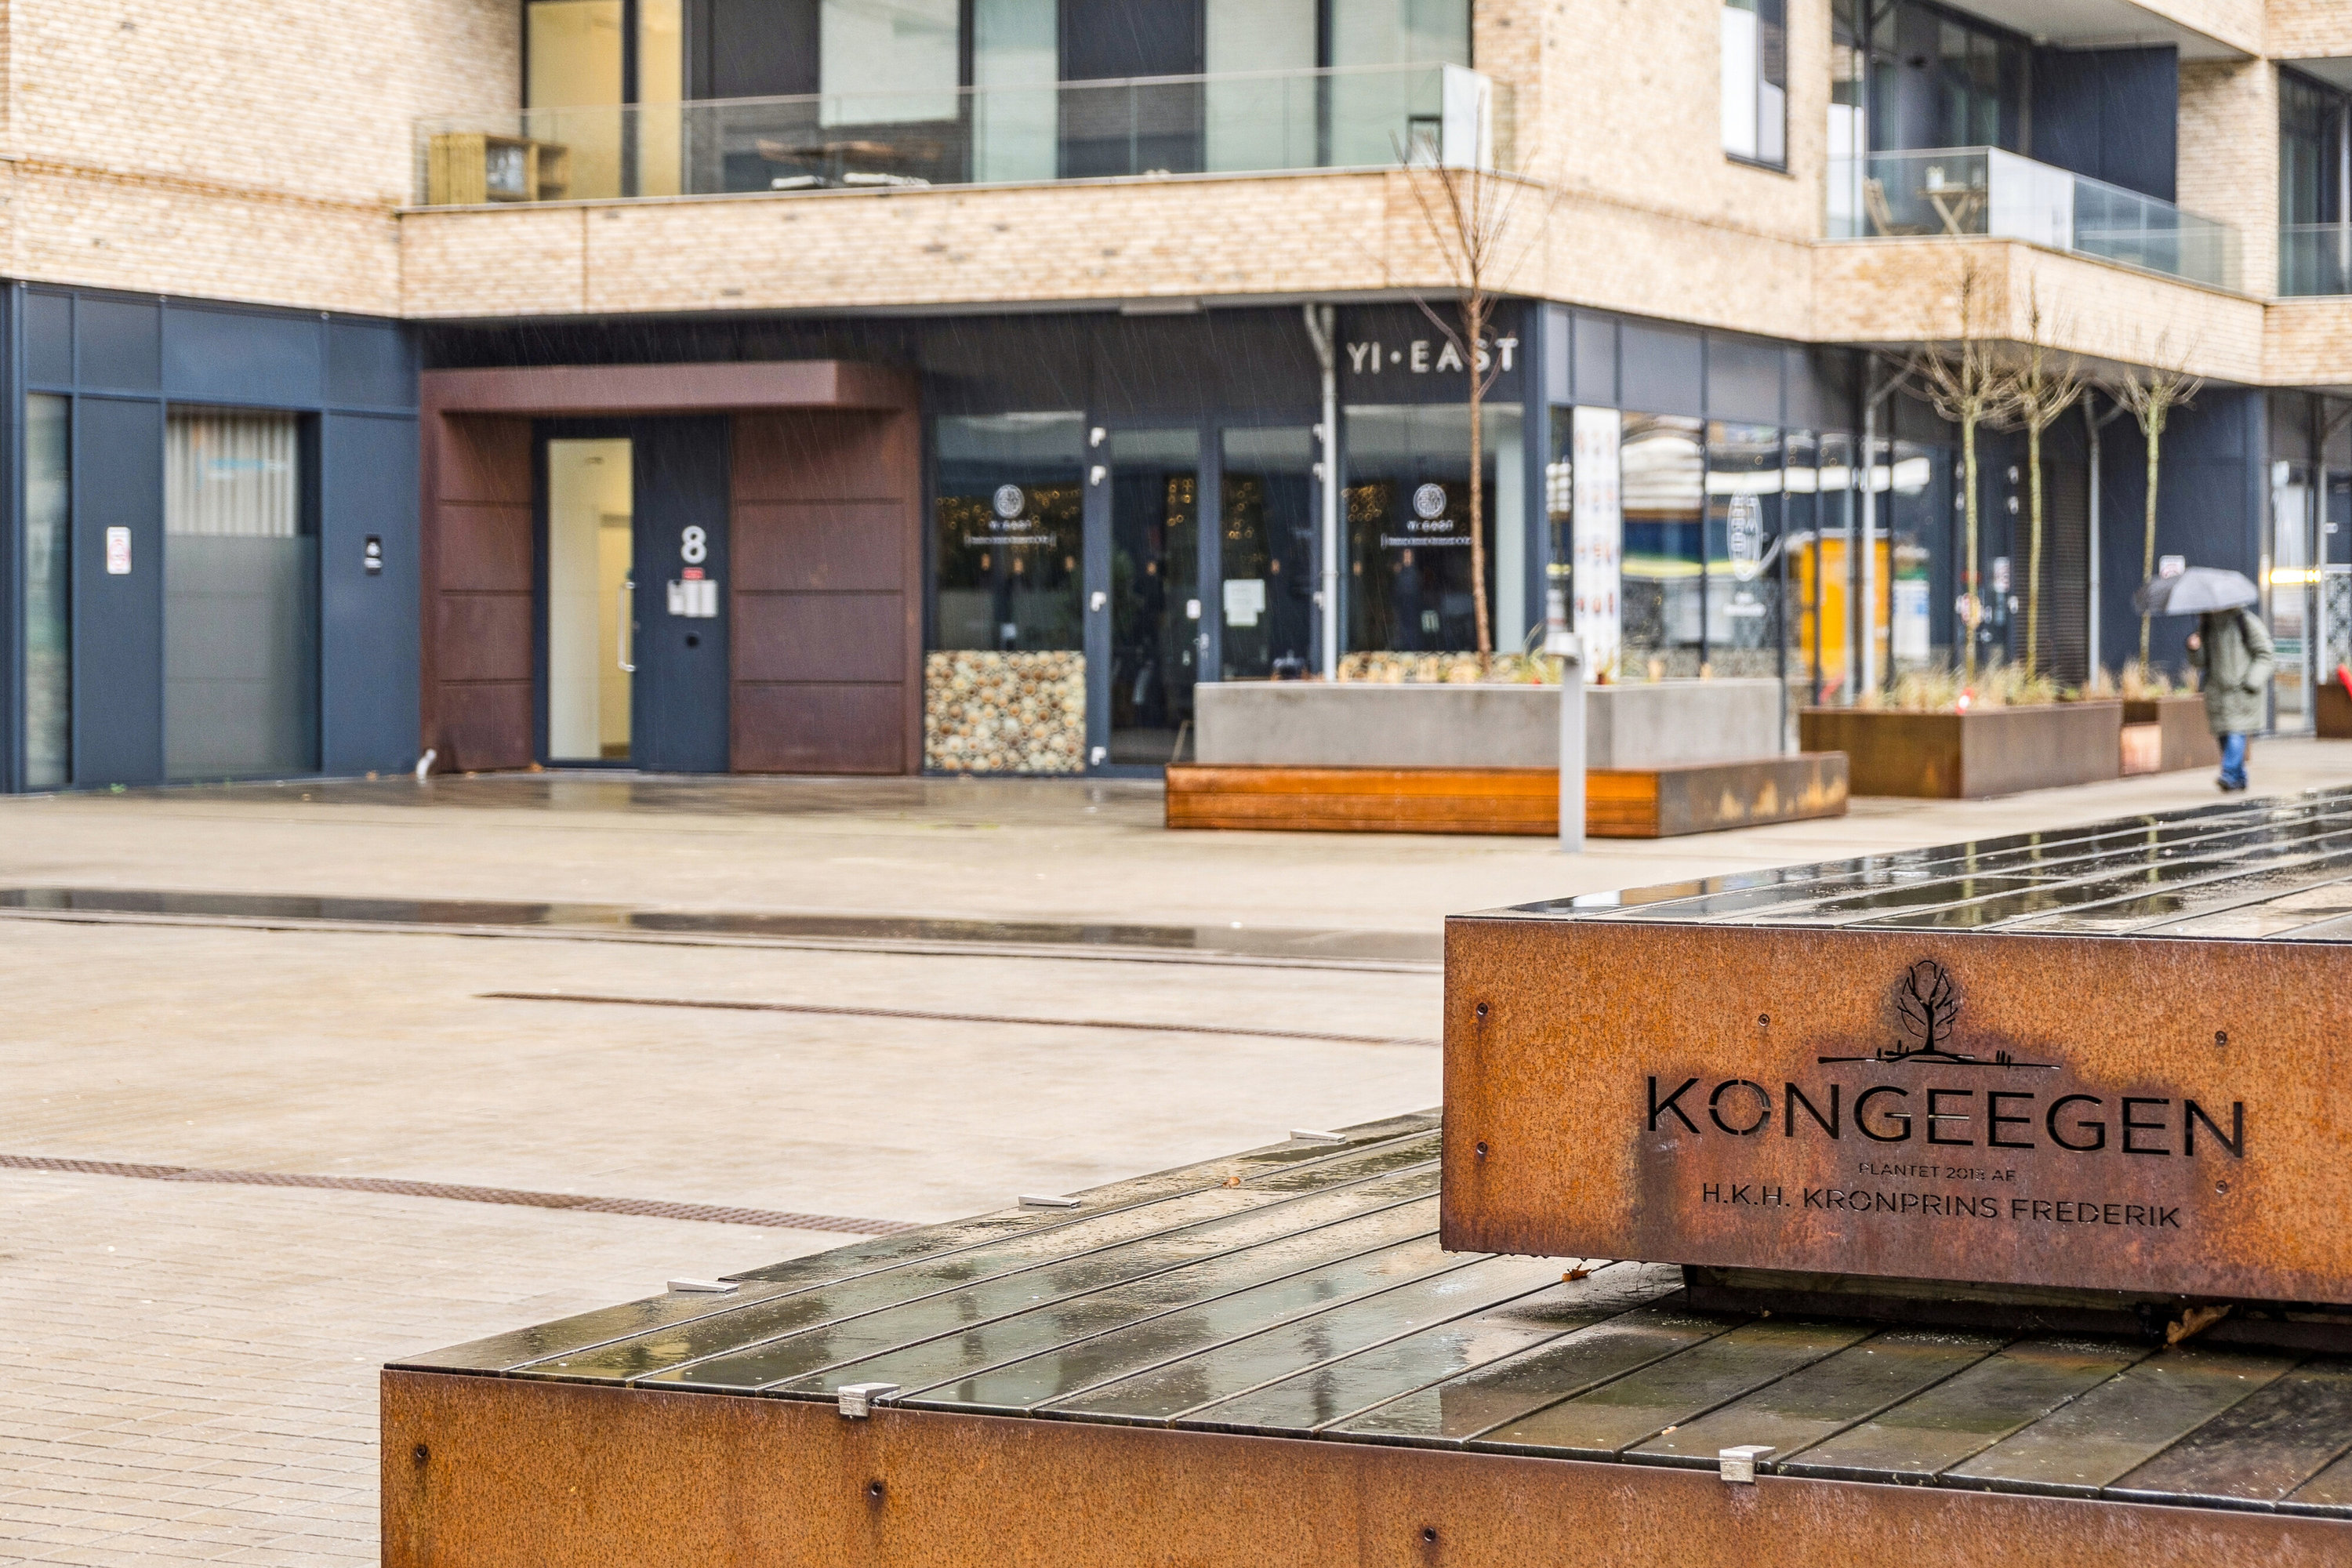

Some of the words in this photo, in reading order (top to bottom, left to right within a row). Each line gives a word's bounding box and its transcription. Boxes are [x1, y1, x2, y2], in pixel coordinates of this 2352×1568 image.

[681, 524, 707, 564] 8
[1648, 1076, 2243, 1159] KONGEEGEN
[1859, 1163, 1940, 1178] PLANTET
[1992, 1170, 2016, 1181] AF
[1703, 1182, 1791, 1207] H.K.H.
[1803, 1188, 1998, 1218] KRONPRINS
[2011, 1198, 2180, 1229] FREDERIK
